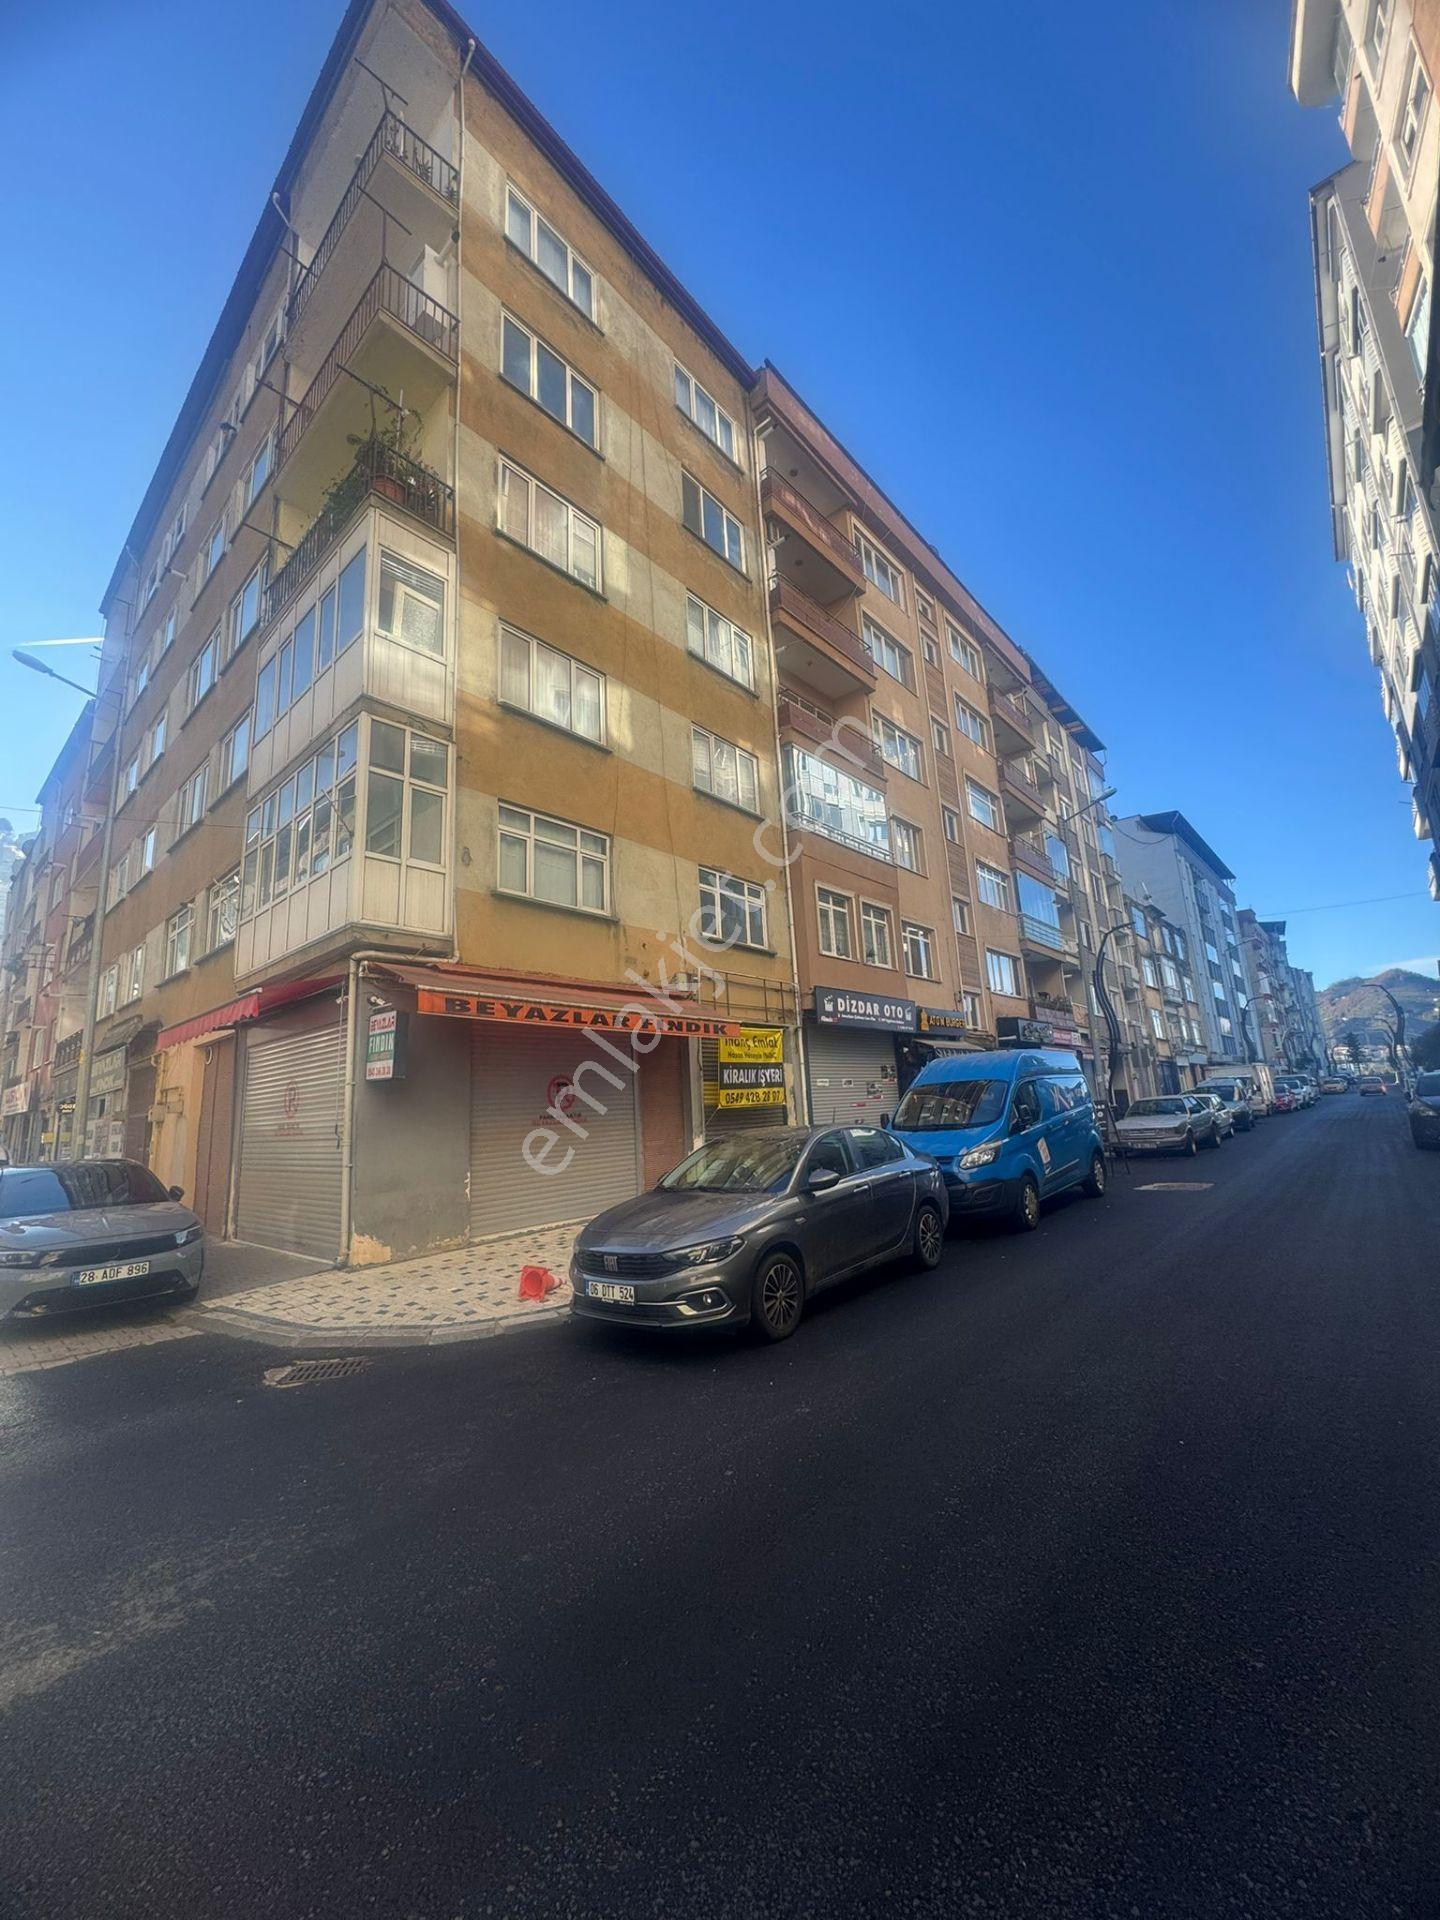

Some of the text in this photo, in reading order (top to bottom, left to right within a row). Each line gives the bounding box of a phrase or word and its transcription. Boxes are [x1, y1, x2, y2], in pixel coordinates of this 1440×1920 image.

[445, 998, 728, 1035] BEYAZLAR FINDIK
[837, 995, 904, 1019] DİZDAR OTO
[752, 1035, 778, 1048] Emlak
[723, 1065, 783, 1087] KİRALIK İŞYERİ
[81, 1263, 148, 1283] 28 ADF 896
[604, 1255, 618, 1272] FIAT
[619, 1286, 634, 1300] 524
